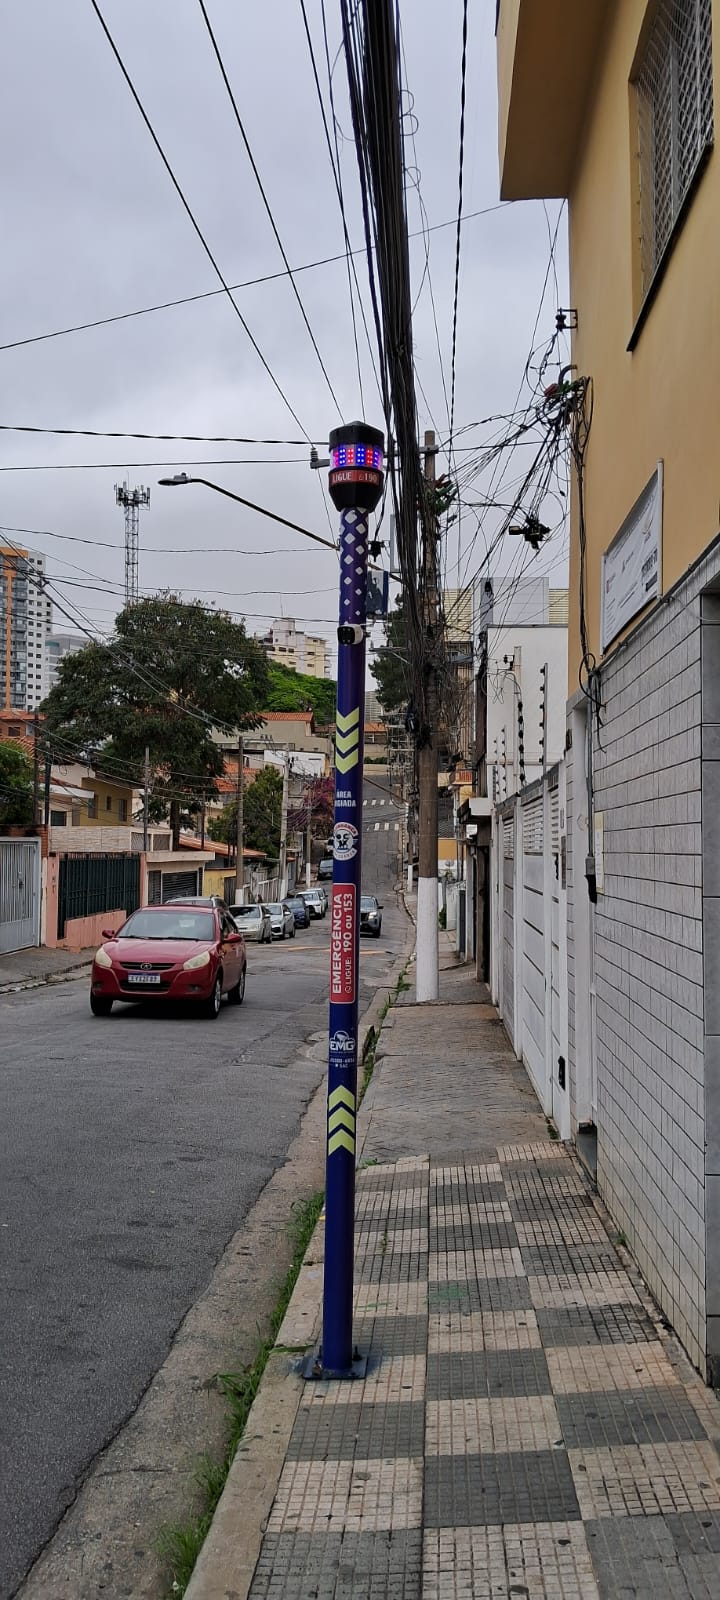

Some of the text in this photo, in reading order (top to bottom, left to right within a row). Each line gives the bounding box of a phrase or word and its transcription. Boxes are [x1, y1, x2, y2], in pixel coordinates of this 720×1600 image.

[331, 472, 377, 483] LIGUE 190
[336, 789, 352, 798] ÁREA
[343, 893, 353, 912] 153
[345, 915, 352, 928] ou
[332, 894, 342, 994] EMERGÊNCIA
[343, 933, 352, 952] 190
[329, 1040, 354, 1051] EMG
